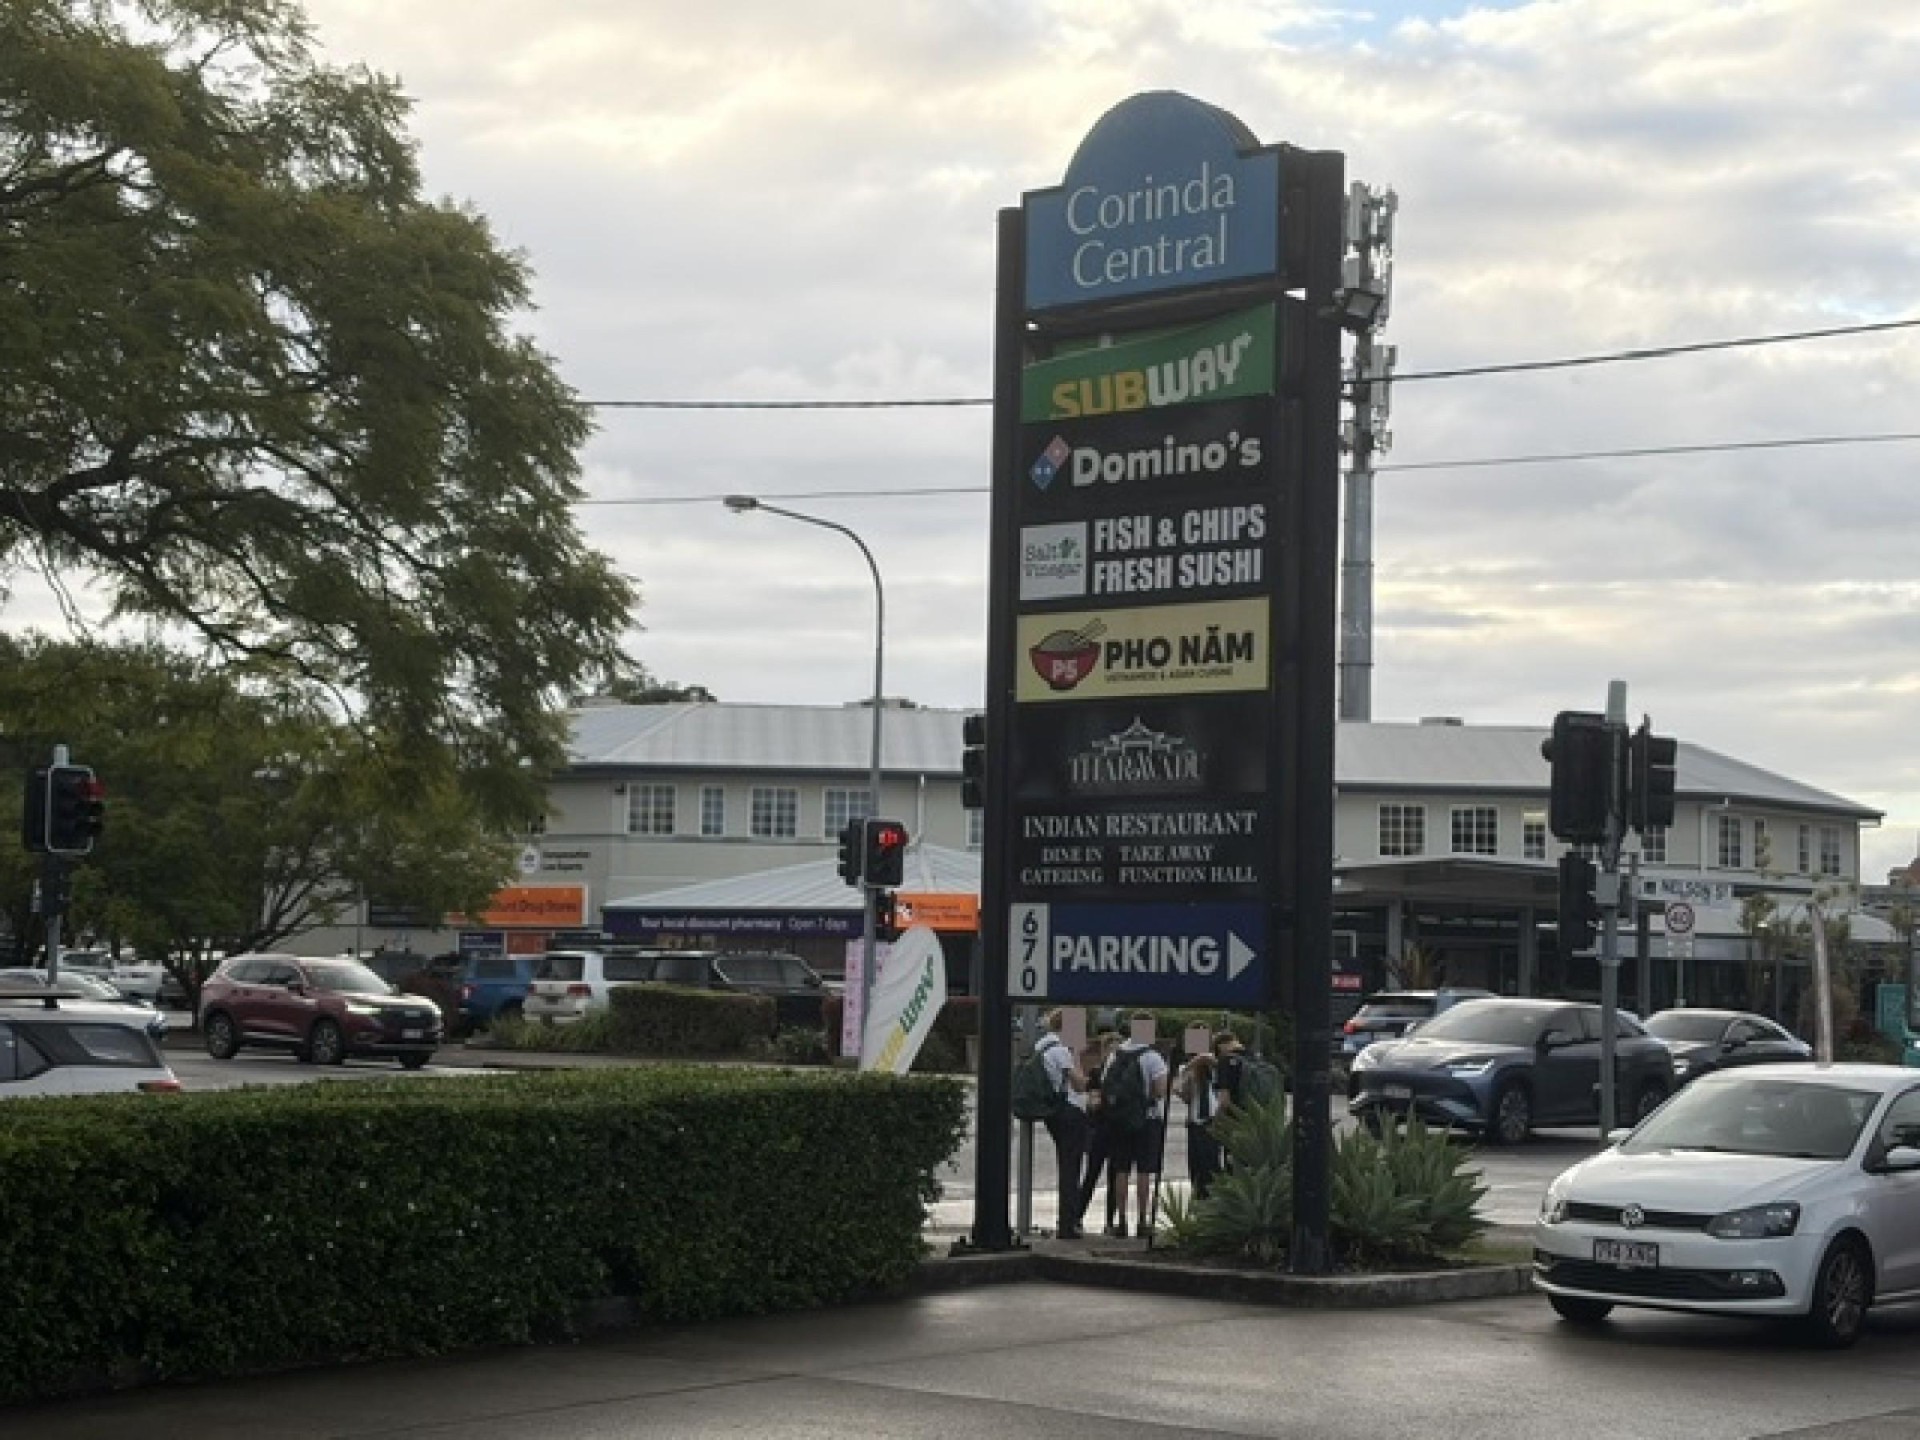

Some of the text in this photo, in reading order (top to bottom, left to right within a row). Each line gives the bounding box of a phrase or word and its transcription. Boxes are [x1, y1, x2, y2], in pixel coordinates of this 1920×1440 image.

[1067, 161, 1237, 235] Corinda
[1073, 213, 1228, 288] Central
[1050, 332, 1252, 420] SUBWAY
[1072, 430, 1261, 487] Domino's
[1094, 503, 1267, 552] FISH & CHIPS
[1093, 549, 1262, 595] FRESH SUSHI
[1104, 624, 1255, 670] PHO NĂM
[1023, 811, 1258, 837] INDIAN RESTAURANT
[1042, 845, 1104, 862] DINE IN
[1118, 844, 1215, 861] TAKE AWAY
[1020, 866, 1105, 883] CATERING
[1118, 866, 1258, 883] FUNCTION HALL
[1662, 879, 1711, 902] NELSON
[686, 916, 730, 928] discount
[731, 917, 781, 931] pharmacy
[788, 916, 815, 930] Open
[1671, 911, 1689, 925] 40
[1052, 935, 1220, 976] PARKING
